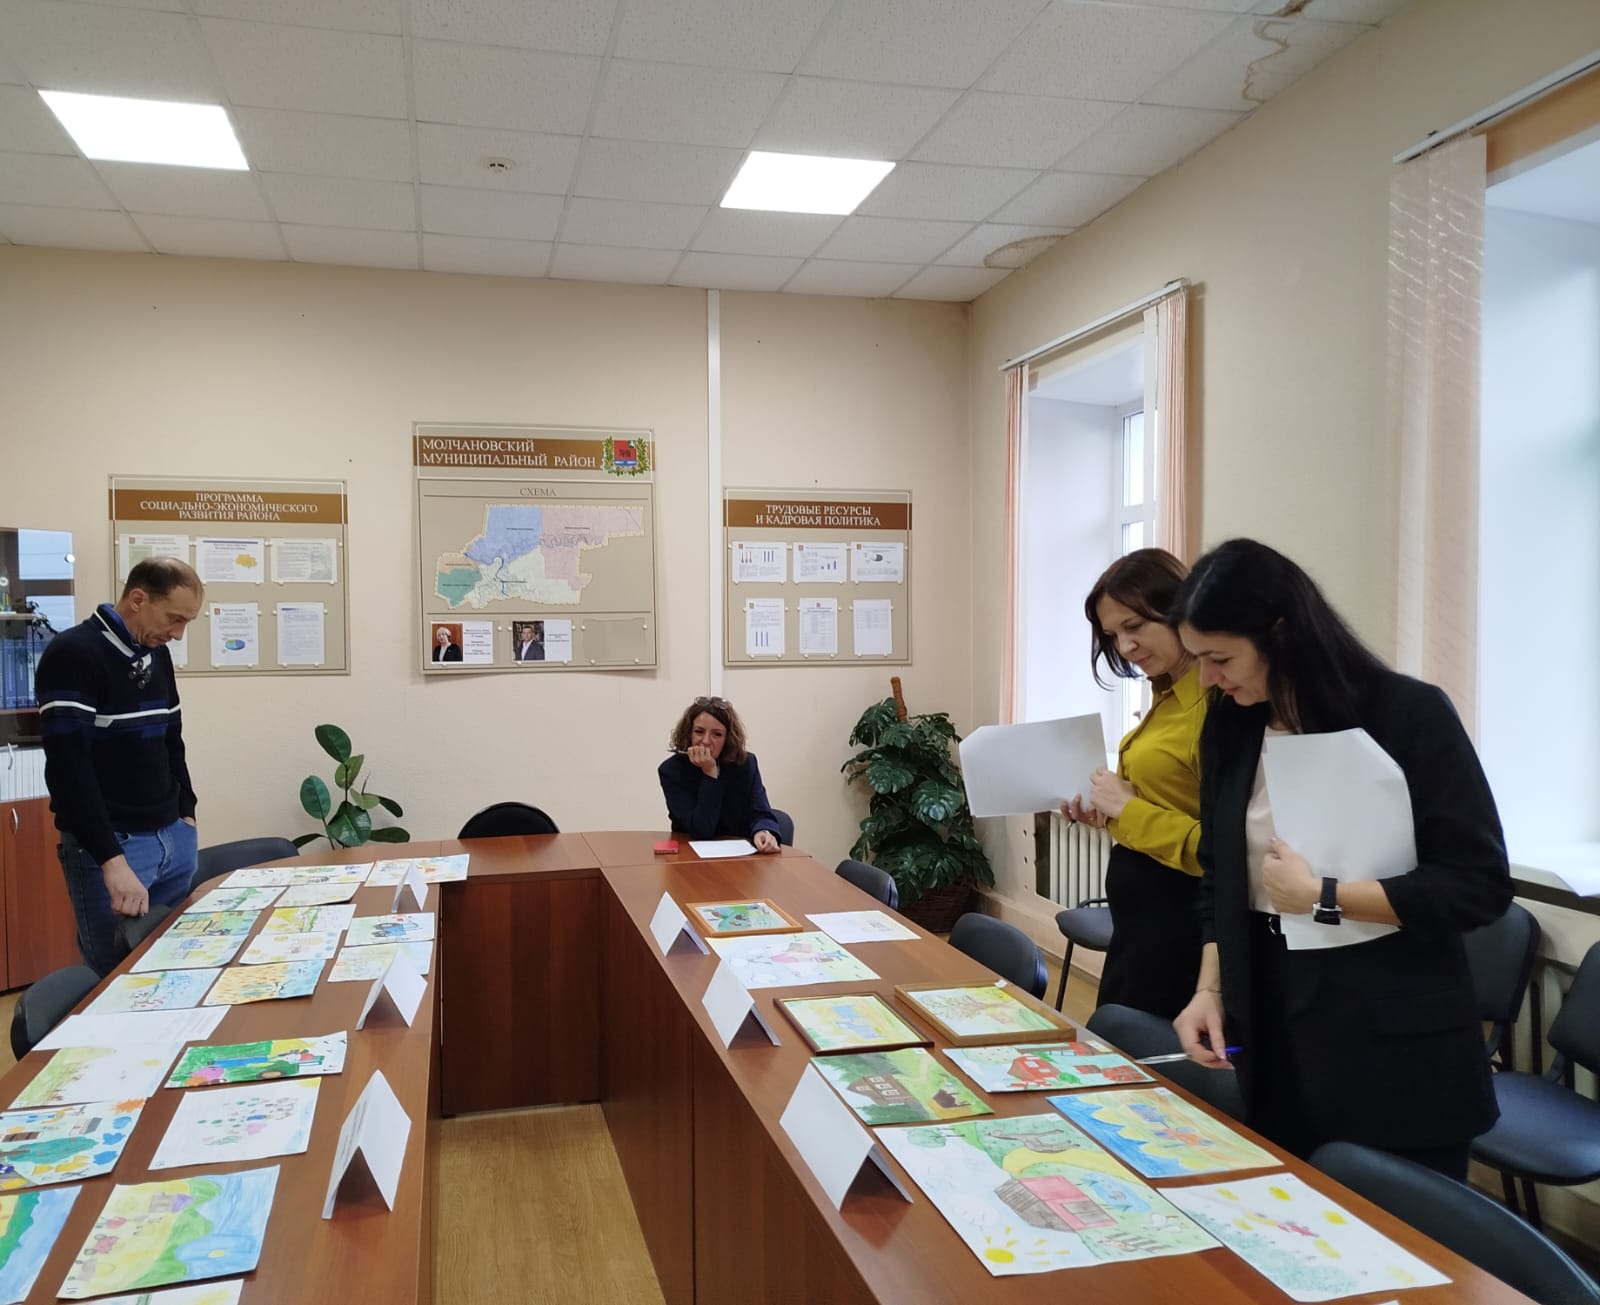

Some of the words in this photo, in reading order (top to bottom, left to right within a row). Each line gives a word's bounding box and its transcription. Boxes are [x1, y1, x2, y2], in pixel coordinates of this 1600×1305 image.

[422, 438, 535, 452] МОЛЧАНОВСКИЙ
[423, 452, 548, 467] МУНИЦИПАЛЬНЫЙ
[554, 454, 596, 467] РАЙОН
[196, 492, 264, 503] ПРОГРАММА
[519, 487, 557, 497] СХЕМА
[140, 500, 318, 513] СОЦИАЛЬНО-ЭКОНОМИЧЕСКОГО
[765, 504, 821, 515] ТРУДОВЫЕ
[824, 505, 871, 516] РЕСУРСЫ
[179, 510, 234, 520] РАЗВИТИЯ
[236, 510, 281, 521] РАЙОНА
[756, 515, 763, 524] И
[766, 515, 822, 526] КАДРОВАЯ
[824, 516, 881, 526] ПОЛИТИКА
